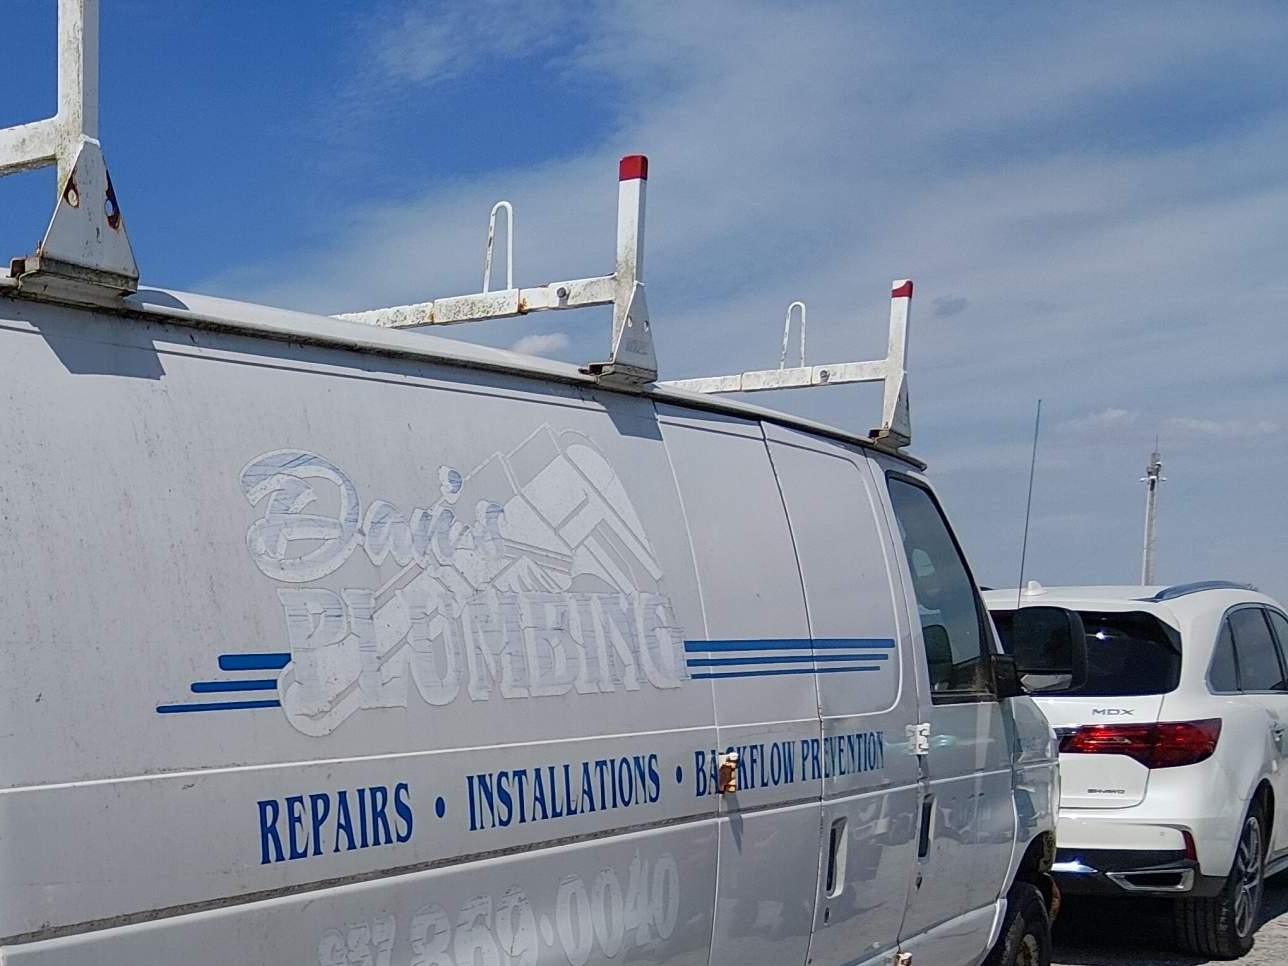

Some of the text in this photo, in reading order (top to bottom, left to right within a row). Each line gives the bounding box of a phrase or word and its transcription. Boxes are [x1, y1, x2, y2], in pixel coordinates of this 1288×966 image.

[1092, 708, 1135, 716] MDX
[257, 782, 414, 865] REPAIRS
[466, 754, 661, 831] INSTALLATIONS
[801, 730, 885, 781] PREVENTION
